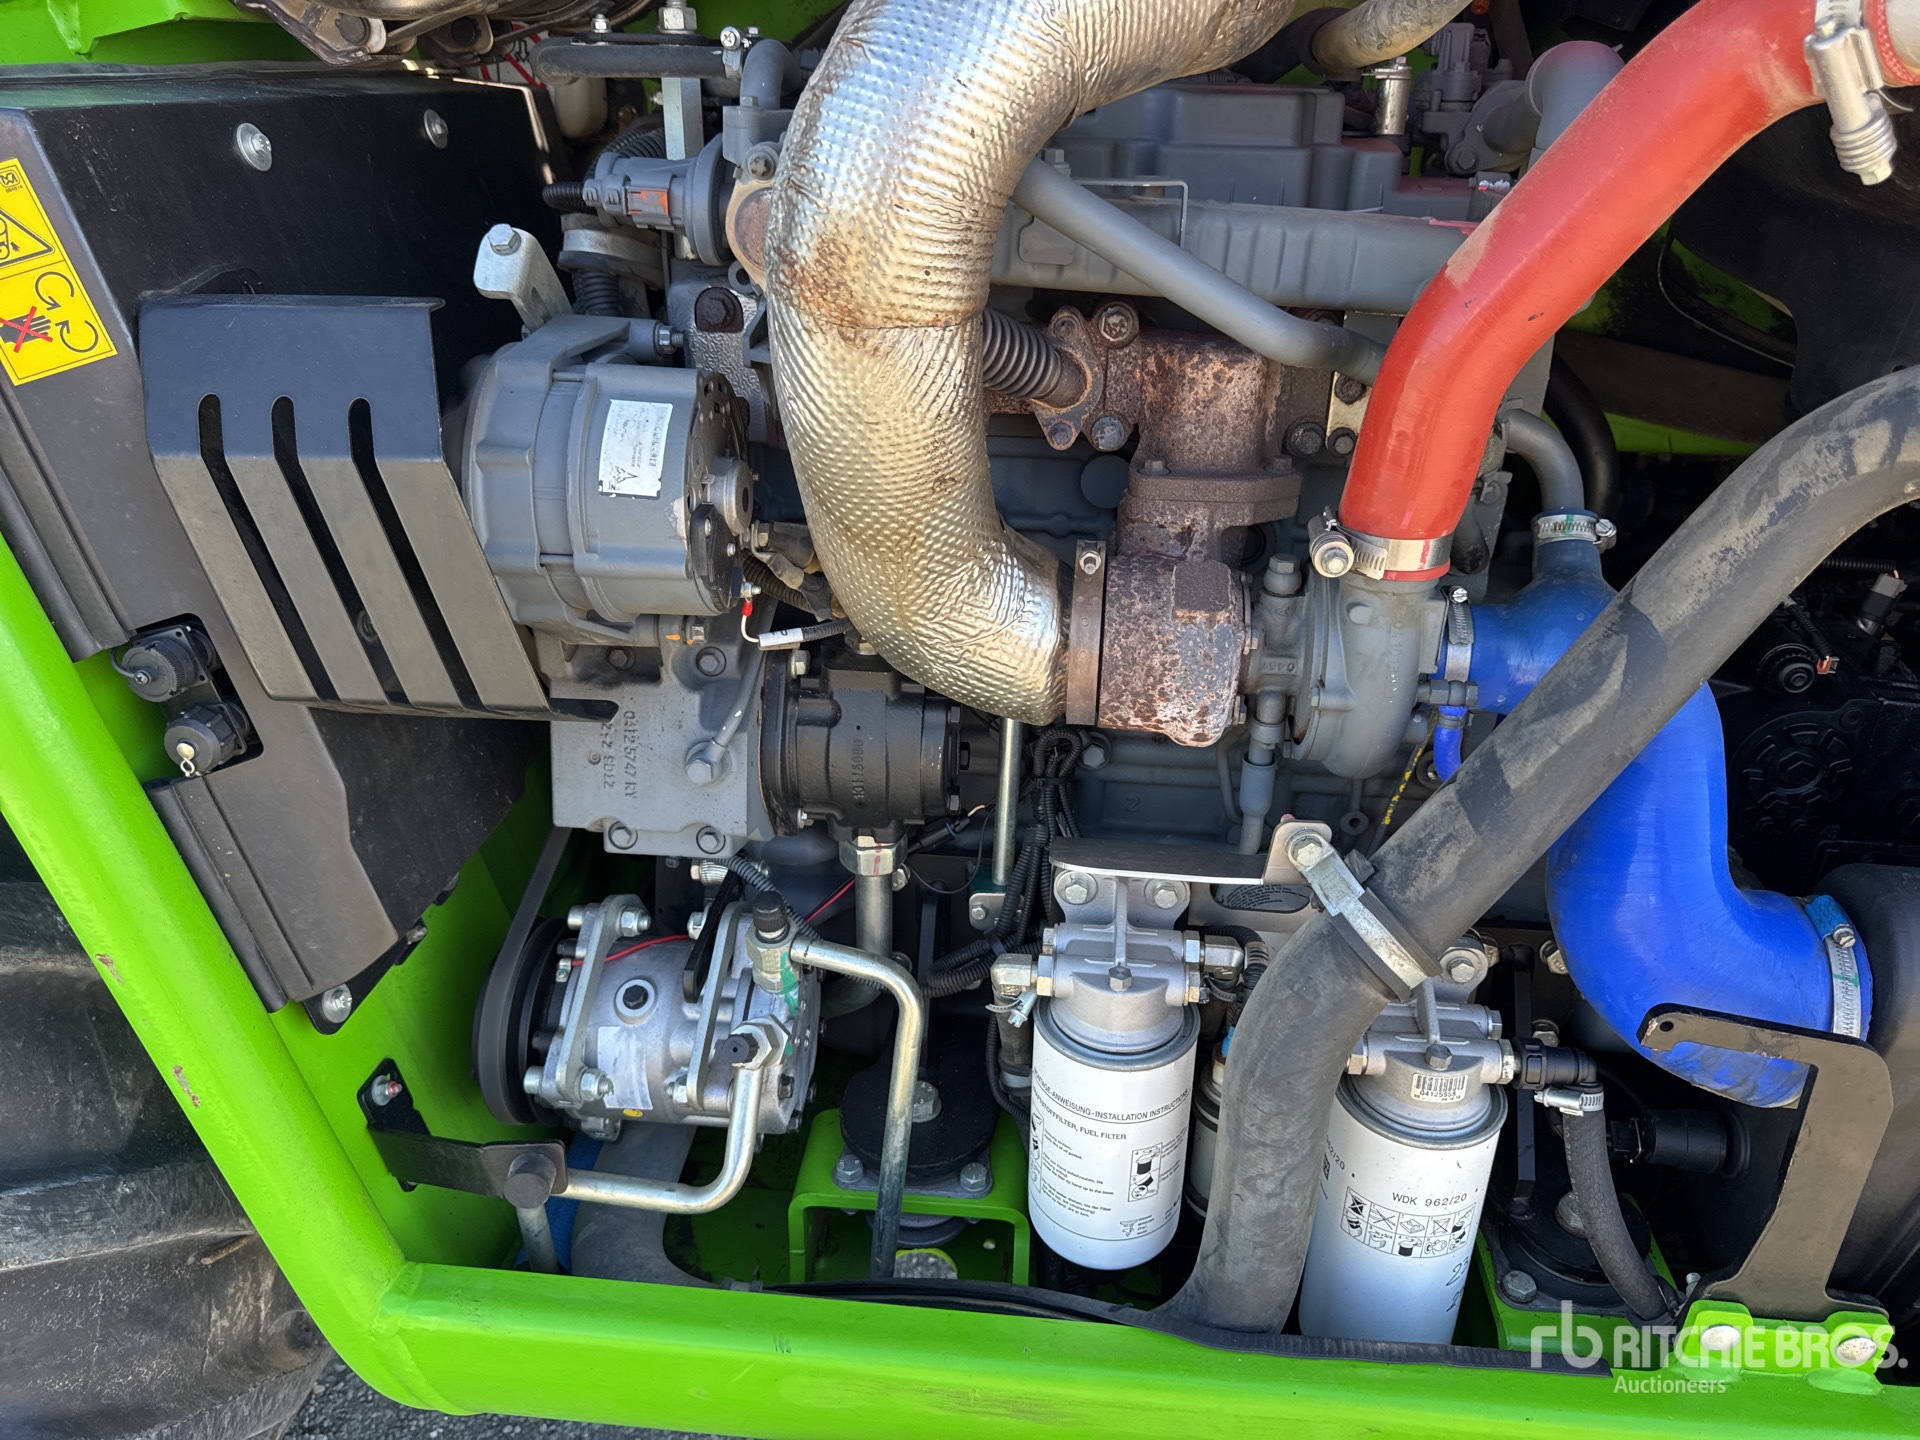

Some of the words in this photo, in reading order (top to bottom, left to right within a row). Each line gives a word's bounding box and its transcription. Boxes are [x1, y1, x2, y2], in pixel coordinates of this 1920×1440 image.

[1095, 1110, 1148, 1121] INSTALLATION
[1079, 1126, 1099, 1138] FUEL
[1100, 1132, 1127, 1140] FILTER
[1392, 1192, 1418, 1206] WDK
[1424, 1193, 1468, 1207] 962/20
